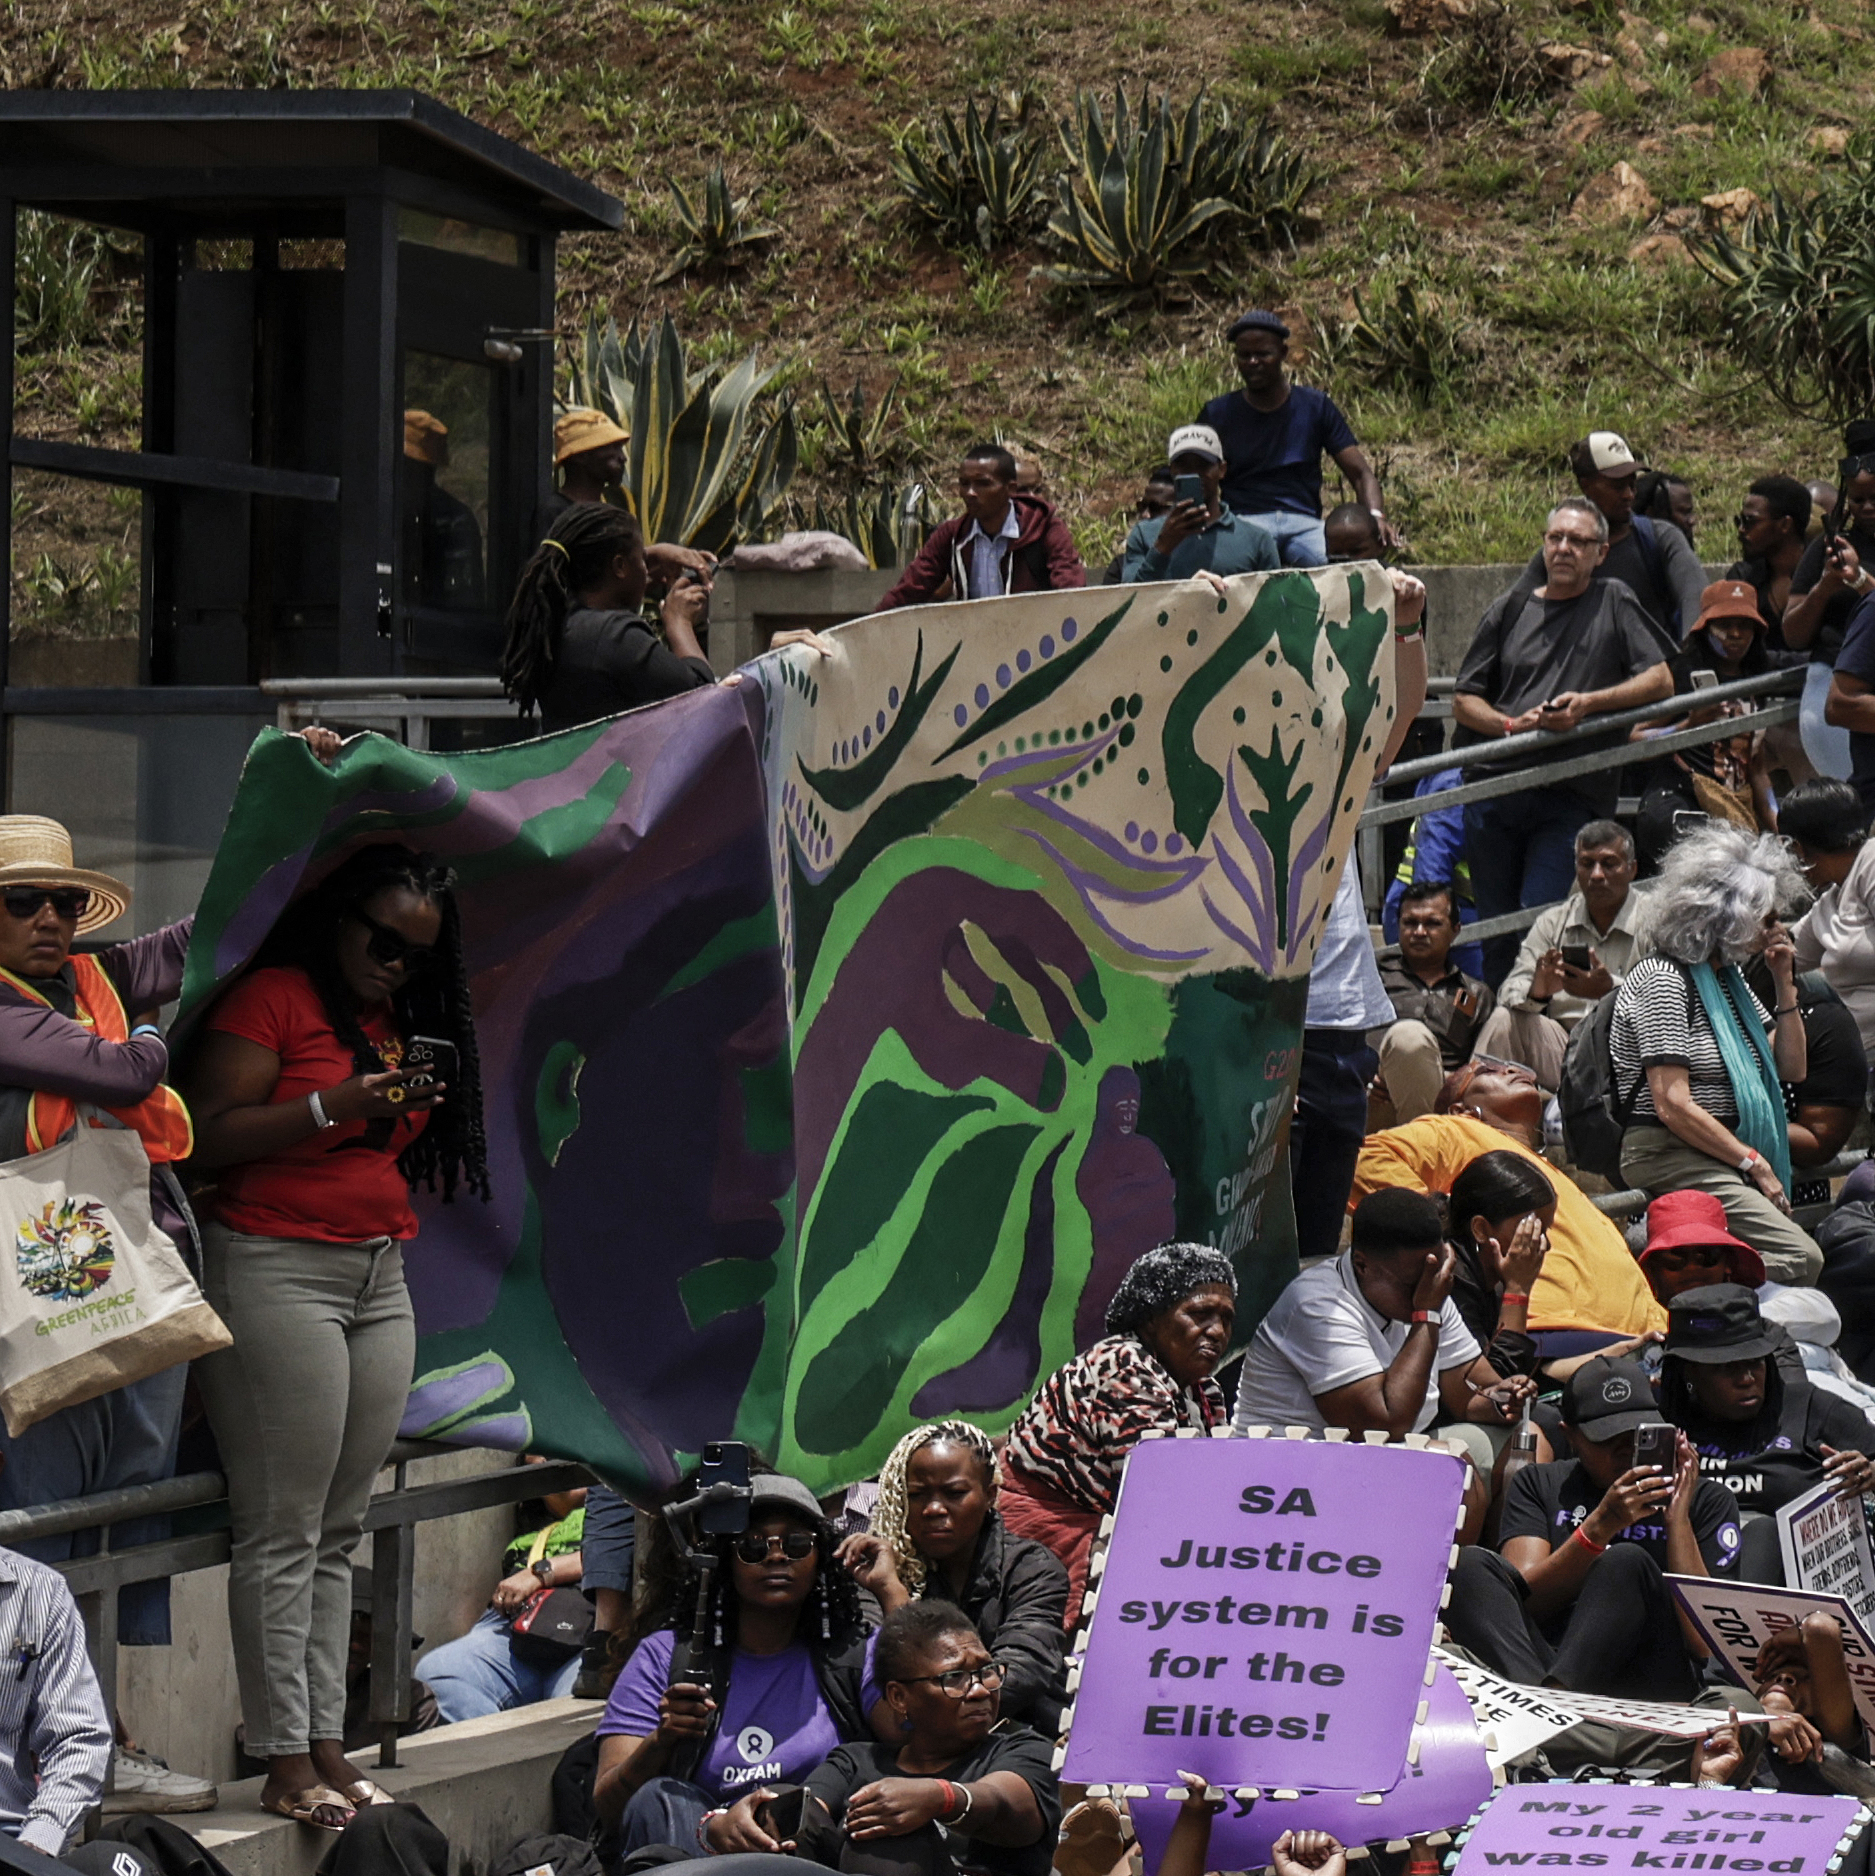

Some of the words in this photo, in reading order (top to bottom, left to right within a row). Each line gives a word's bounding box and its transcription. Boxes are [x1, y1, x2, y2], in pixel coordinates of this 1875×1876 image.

[35, 1288, 136, 1337] GREENPEACE
[91, 1307, 147, 1336] AFRICA
[1238, 1485, 1317, 1518] SA
[1159, 1539, 1382, 1578] Justice
[1118, 1595, 1329, 1631] system
[1351, 1604, 1405, 1637] is
[1703, 1604, 1757, 1647] FOR
[1148, 1648, 1228, 1679] for
[1247, 1652, 1346, 1687] the
[1474, 1675, 1575, 1729] TIMES
[1142, 1704, 1331, 1742] Elites!
[1518, 1800, 1608, 1817] My
[1627, 1804, 1663, 1817] 2
[1682, 1808, 1826, 1825] year
[1546, 1824, 1643, 1840] old
[1659, 1829, 1767, 1845] girl
[1483, 1850, 1610, 1868] was
[1630, 1850, 1807, 1875] killed
